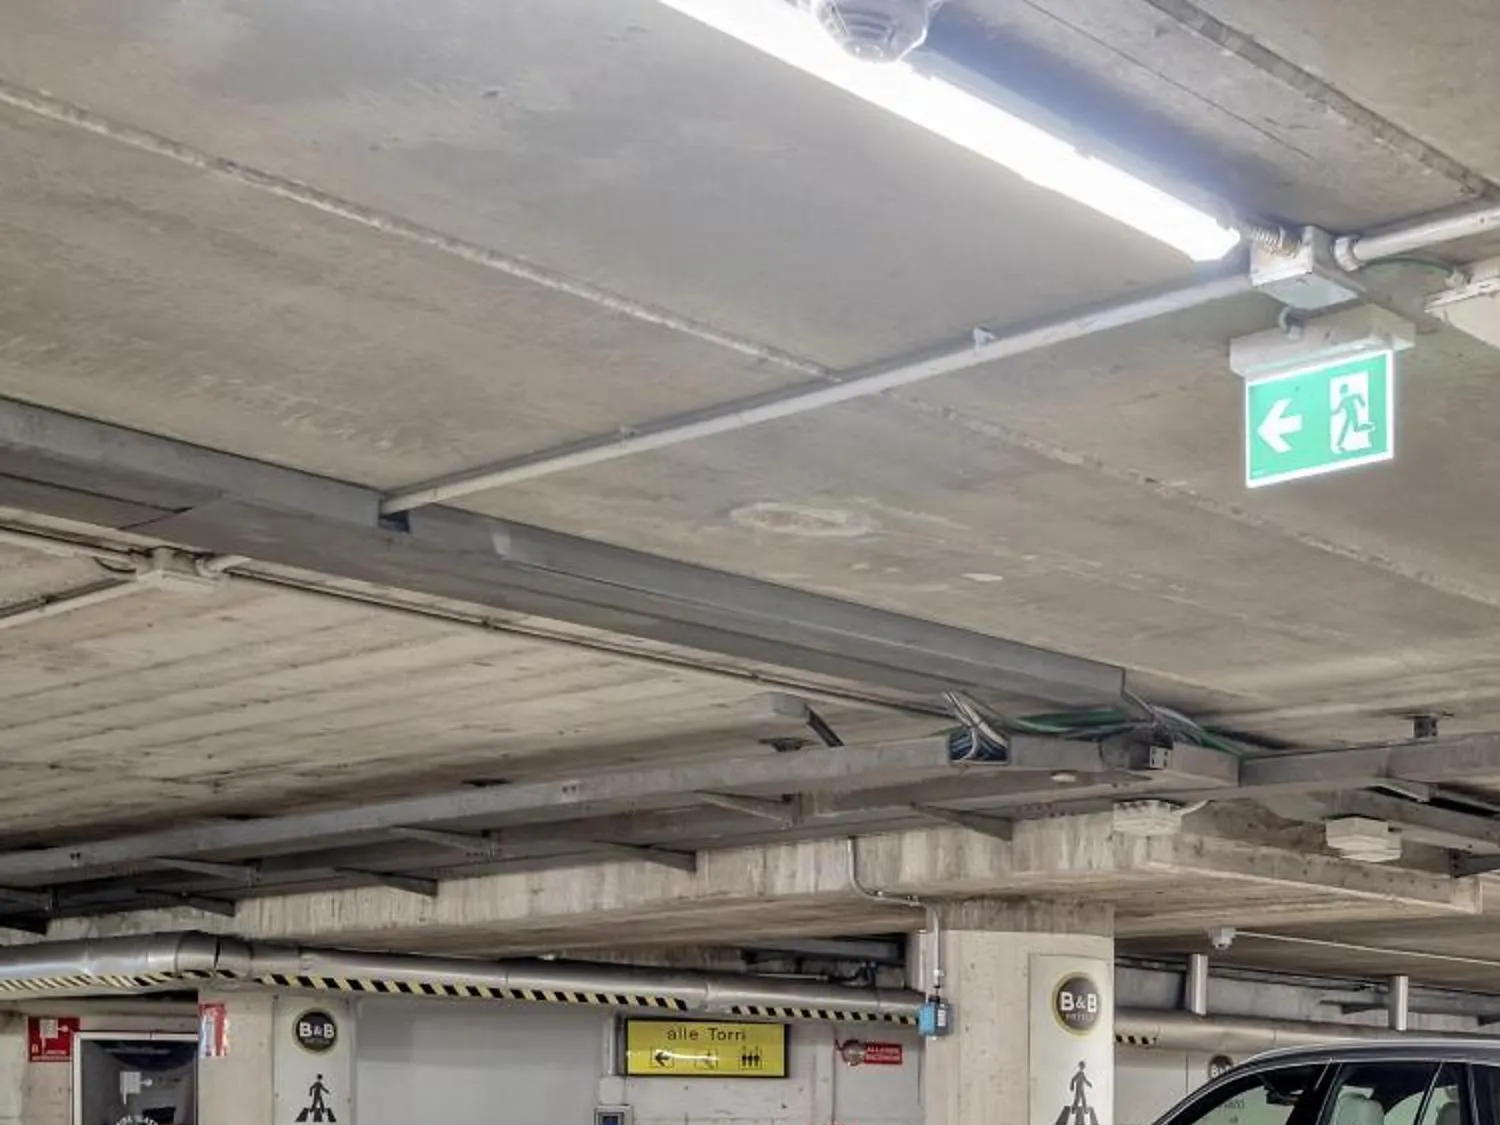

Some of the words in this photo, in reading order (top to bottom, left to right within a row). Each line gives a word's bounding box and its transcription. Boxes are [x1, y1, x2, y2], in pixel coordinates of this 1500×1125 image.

[1060, 991, 1097, 1013] B&B
[299, 1021, 335, 1039] B&B
[666, 1027, 699, 1041] alle
[706, 1027, 746, 1041] Torri
